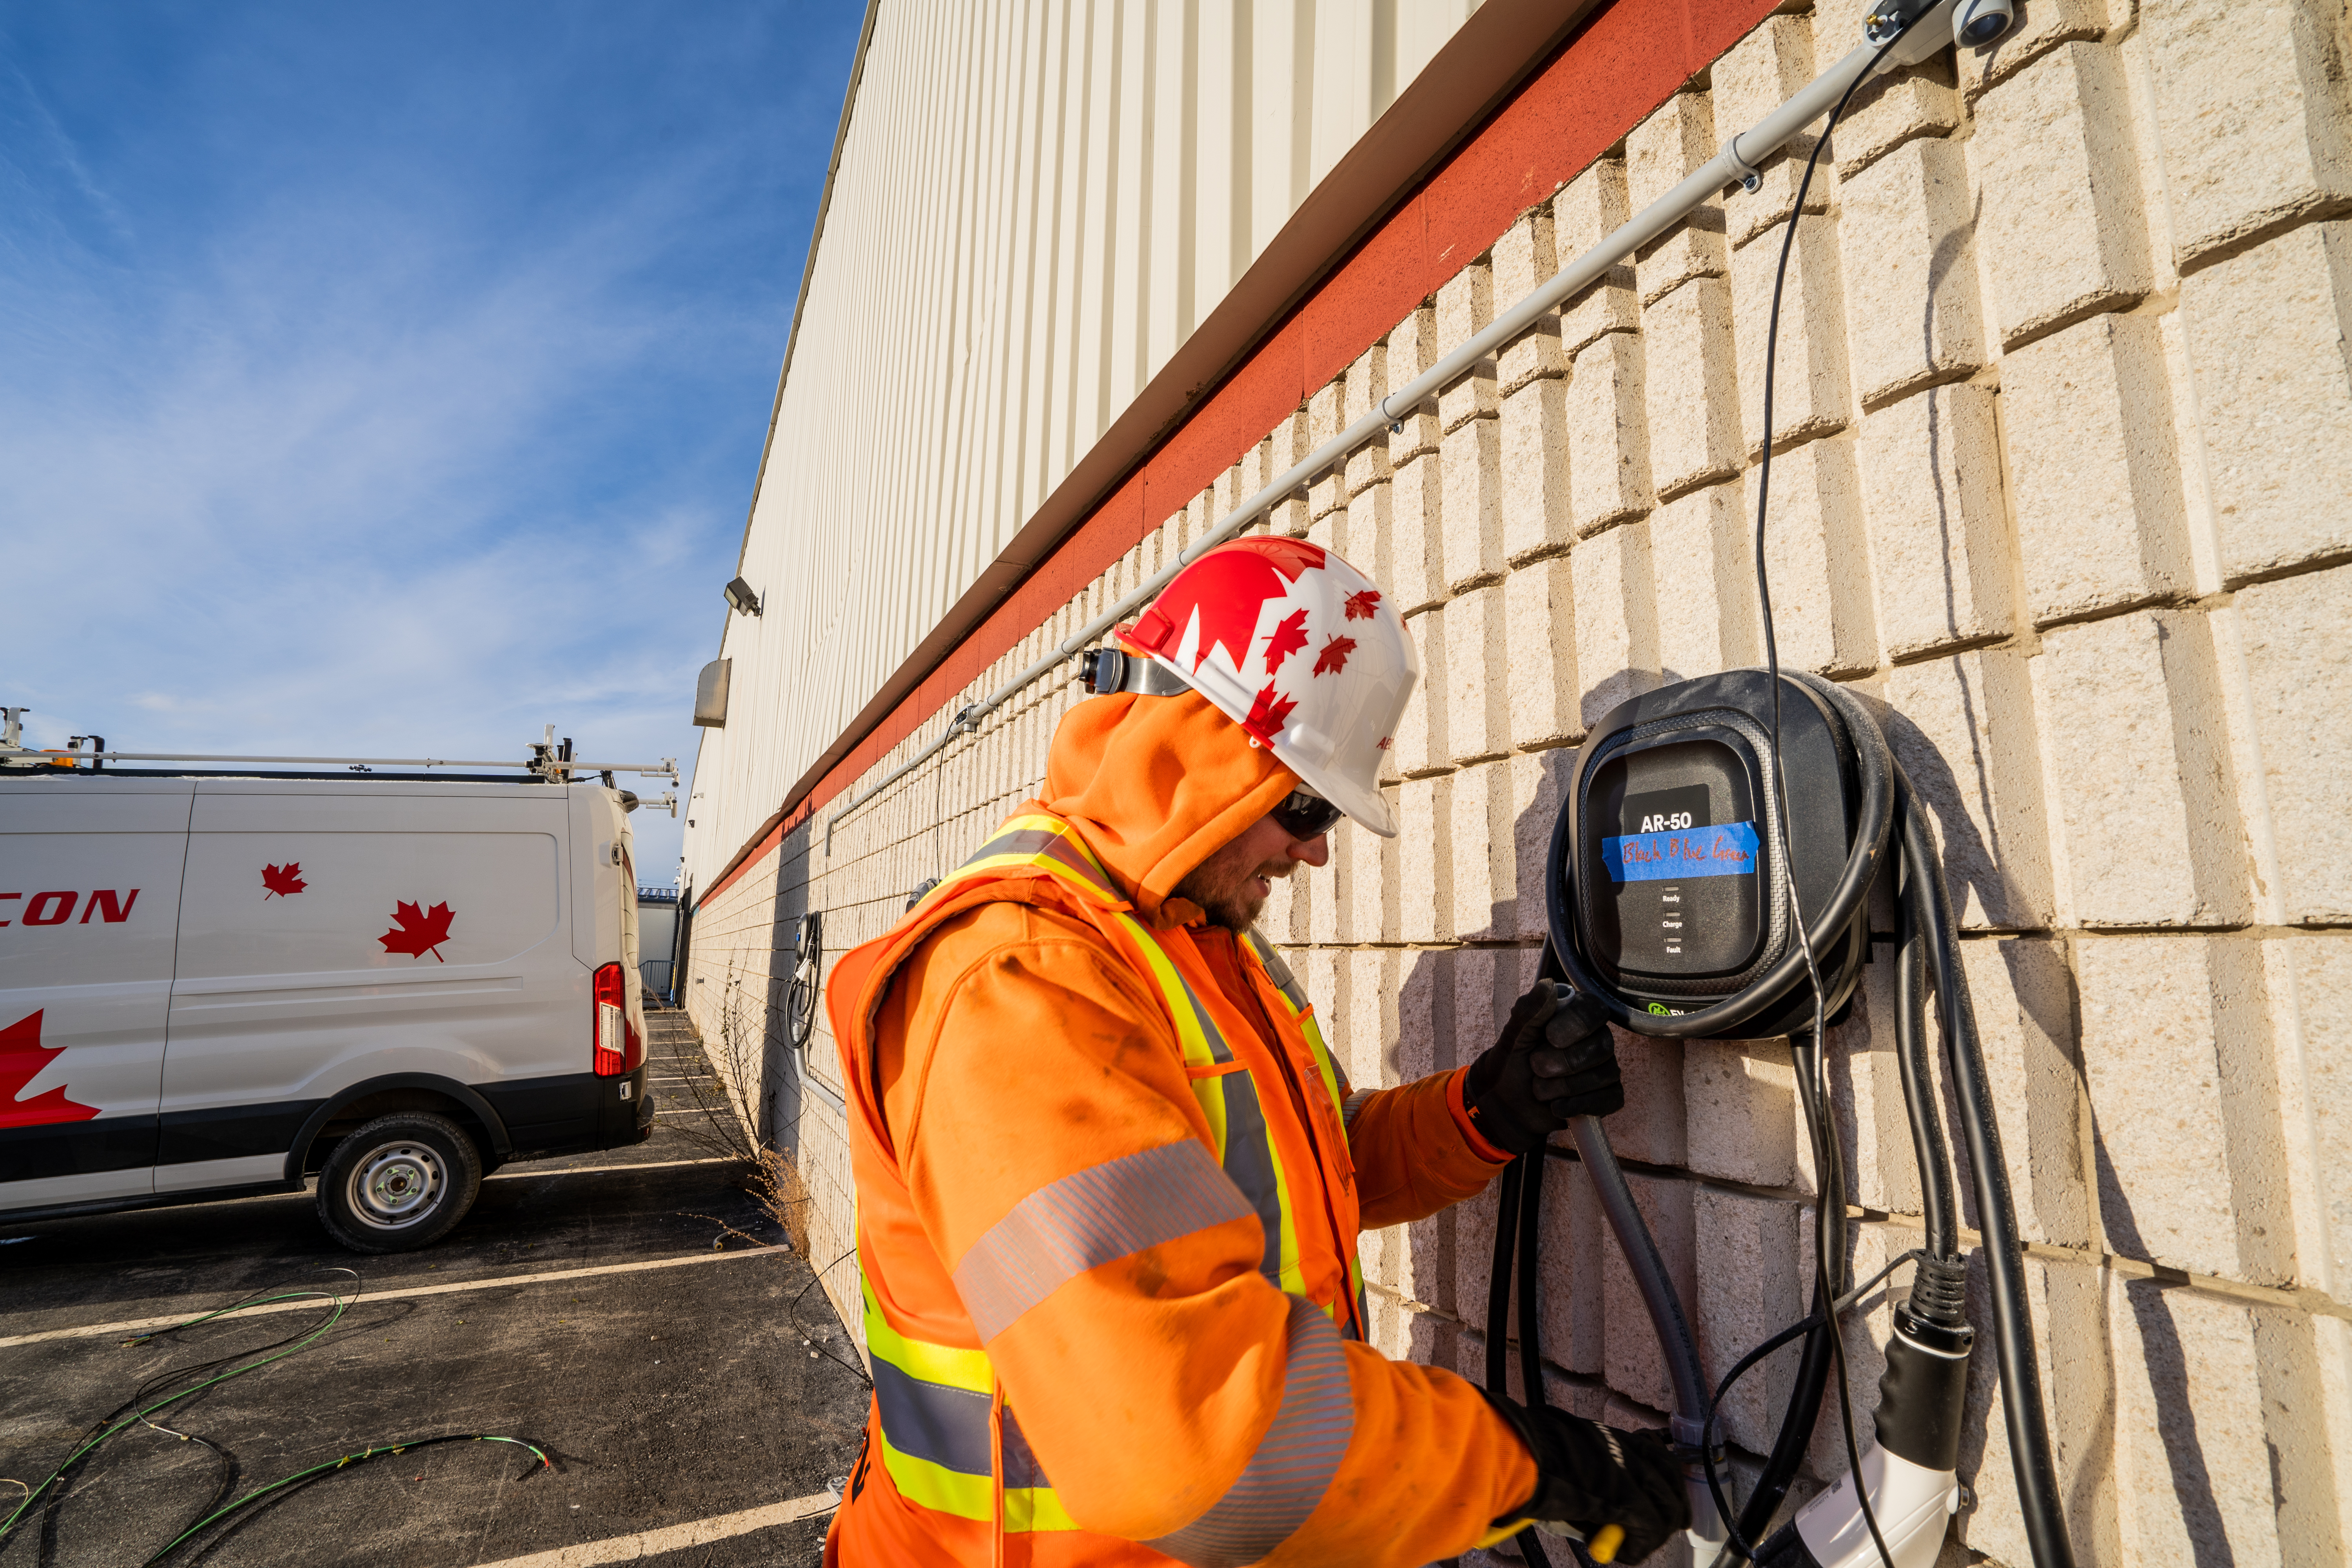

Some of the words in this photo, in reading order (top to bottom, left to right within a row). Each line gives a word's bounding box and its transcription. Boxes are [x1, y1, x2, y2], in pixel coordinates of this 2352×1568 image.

[1641, 811, 1691, 833] AR-50
[1623, 840, 1662, 864] Black
[1670, 837, 1707, 861] Blue
[1712, 835, 1749, 862] Green
